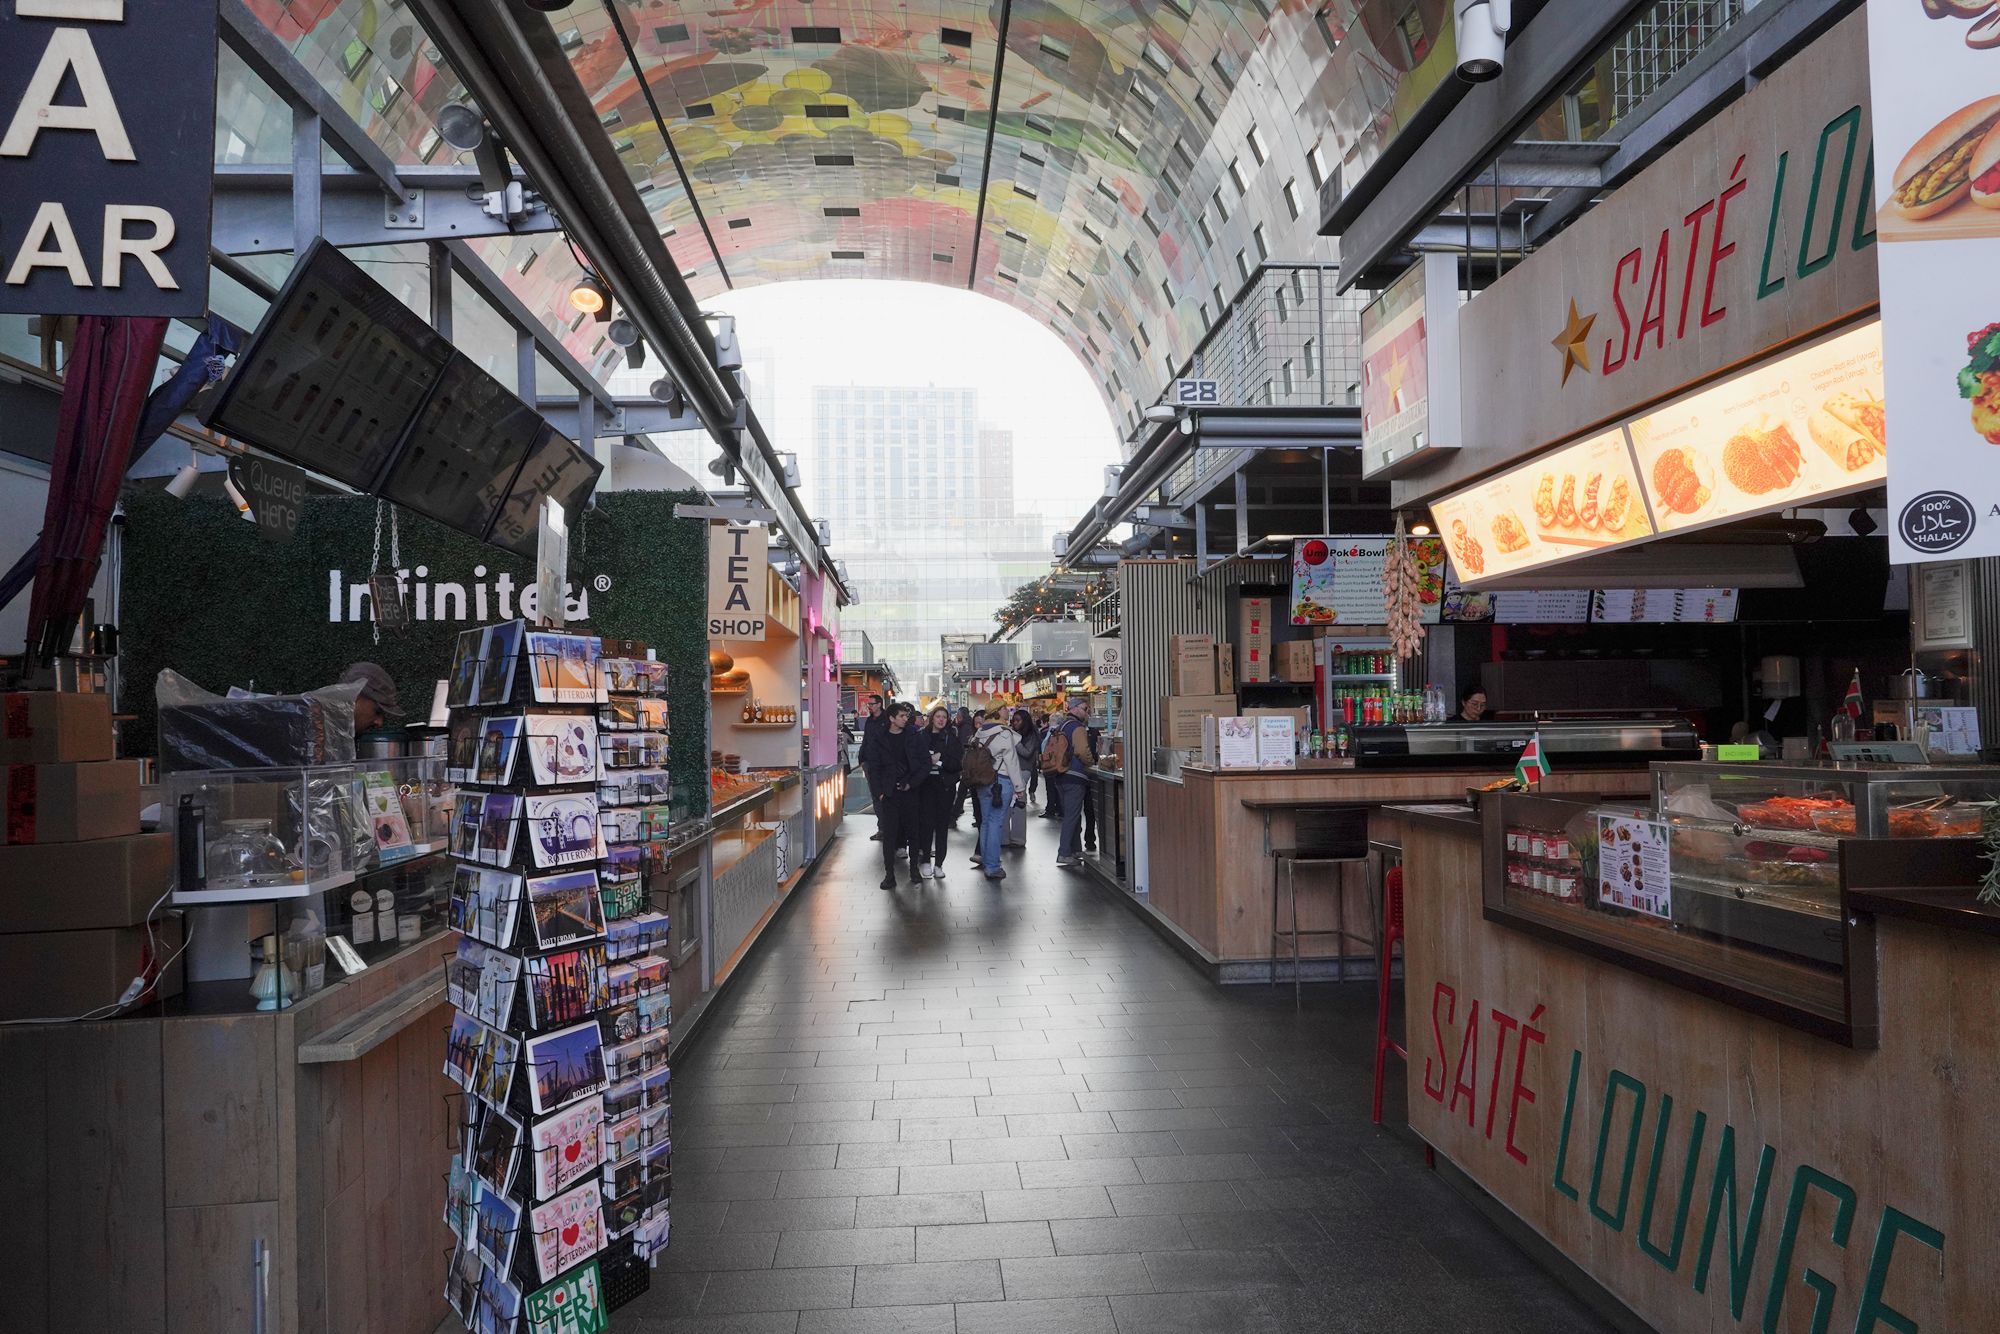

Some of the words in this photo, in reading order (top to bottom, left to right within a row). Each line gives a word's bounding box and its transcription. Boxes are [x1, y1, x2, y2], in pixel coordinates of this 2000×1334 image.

[1603, 154, 1747, 376] SATÉ
[1179, 381, 1217, 402] 28
[250, 459, 306, 506] Queue
[258, 496, 297, 533] Here
[1920, 499, 1951, 512] 100%
[1911, 511, 1962, 536] حلال
[1918, 530, 1956, 543] HALAL
[1329, 545, 1385, 558] PokéBowl
[724, 528, 751, 611] TEA
[709, 619, 764, 636] SHOP
[1098, 665, 1123, 676] COCOS
[1424, 982, 1544, 1166] SATÉ
[557, 1159, 594, 1185] ROTTERDAM
[1552, 1049, 1946, 1334] LOUNGE
[562, 1217, 577, 1227] LOVE
[557, 1244, 594, 1268] ROTTERDAM
